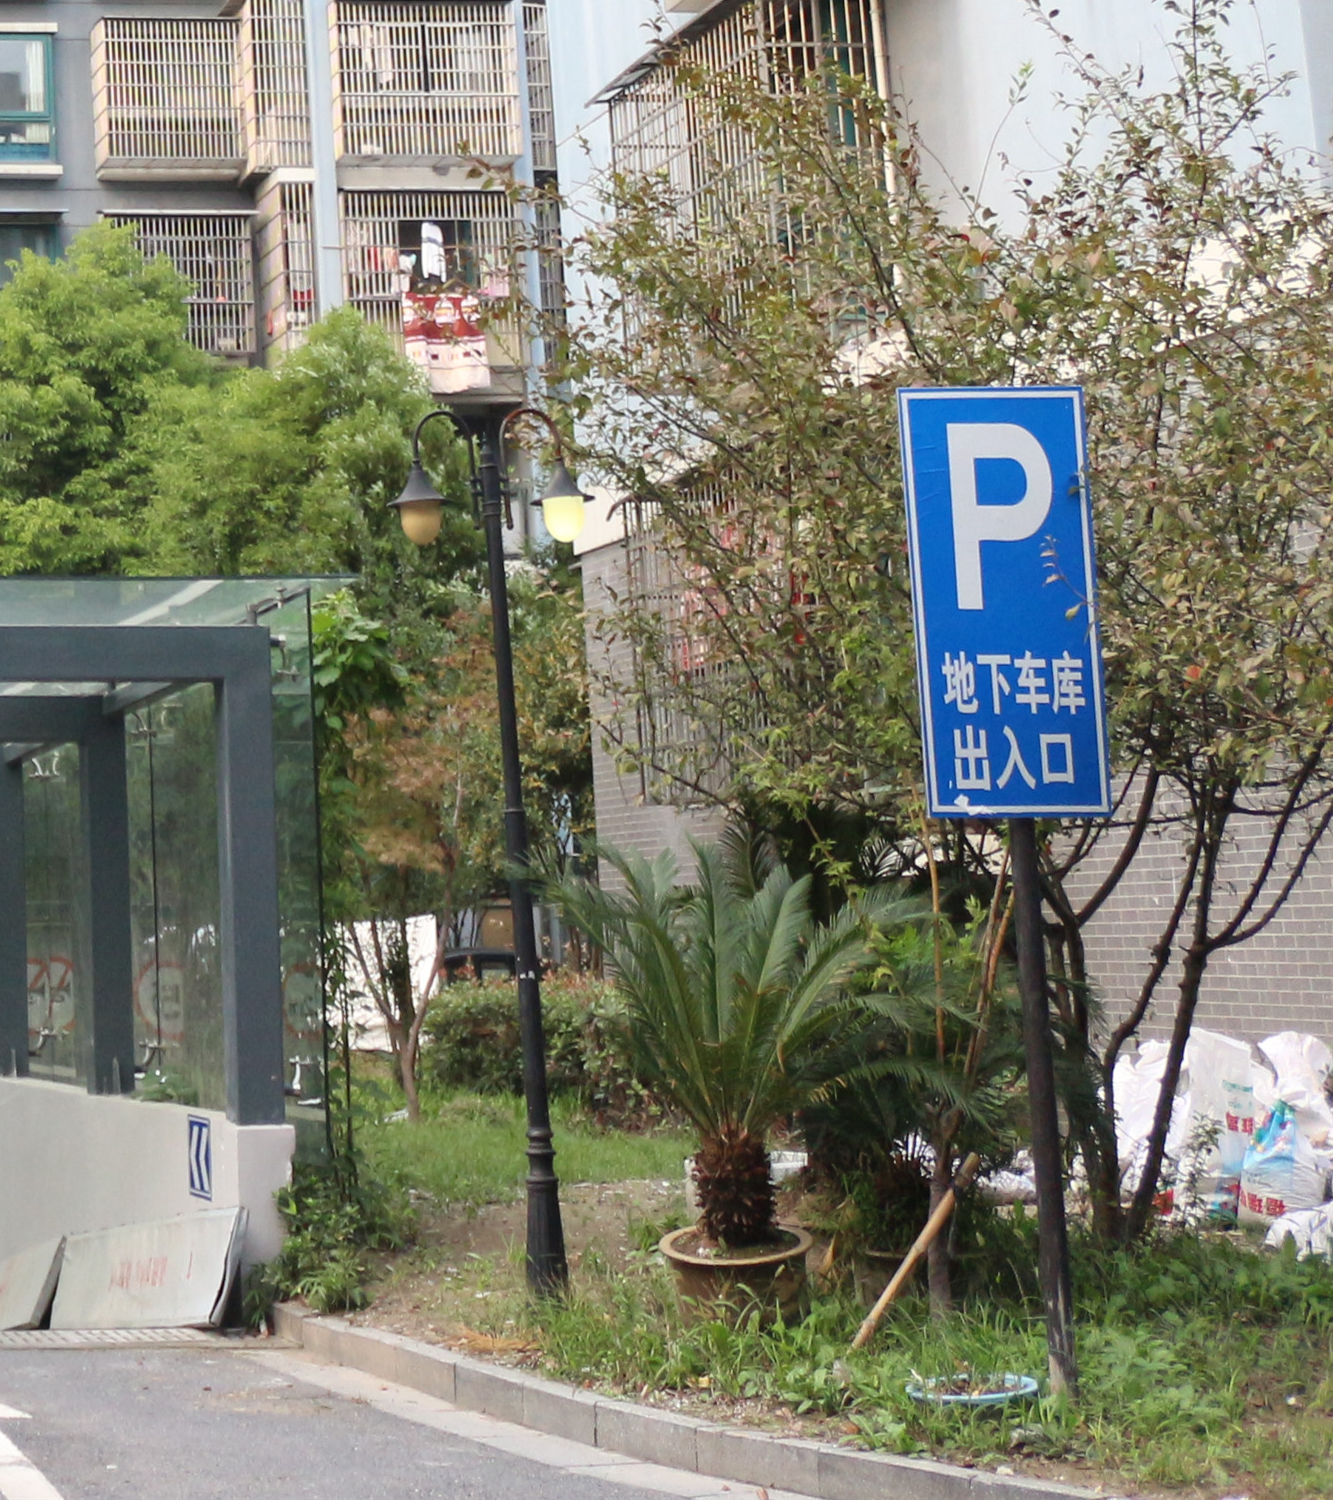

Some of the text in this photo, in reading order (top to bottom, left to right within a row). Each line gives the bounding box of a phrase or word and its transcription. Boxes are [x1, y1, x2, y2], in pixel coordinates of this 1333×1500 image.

[945, 421, 1053, 611] P
[941, 649, 1086, 716] 地下车库
[952, 724, 1076, 791] 出入口
